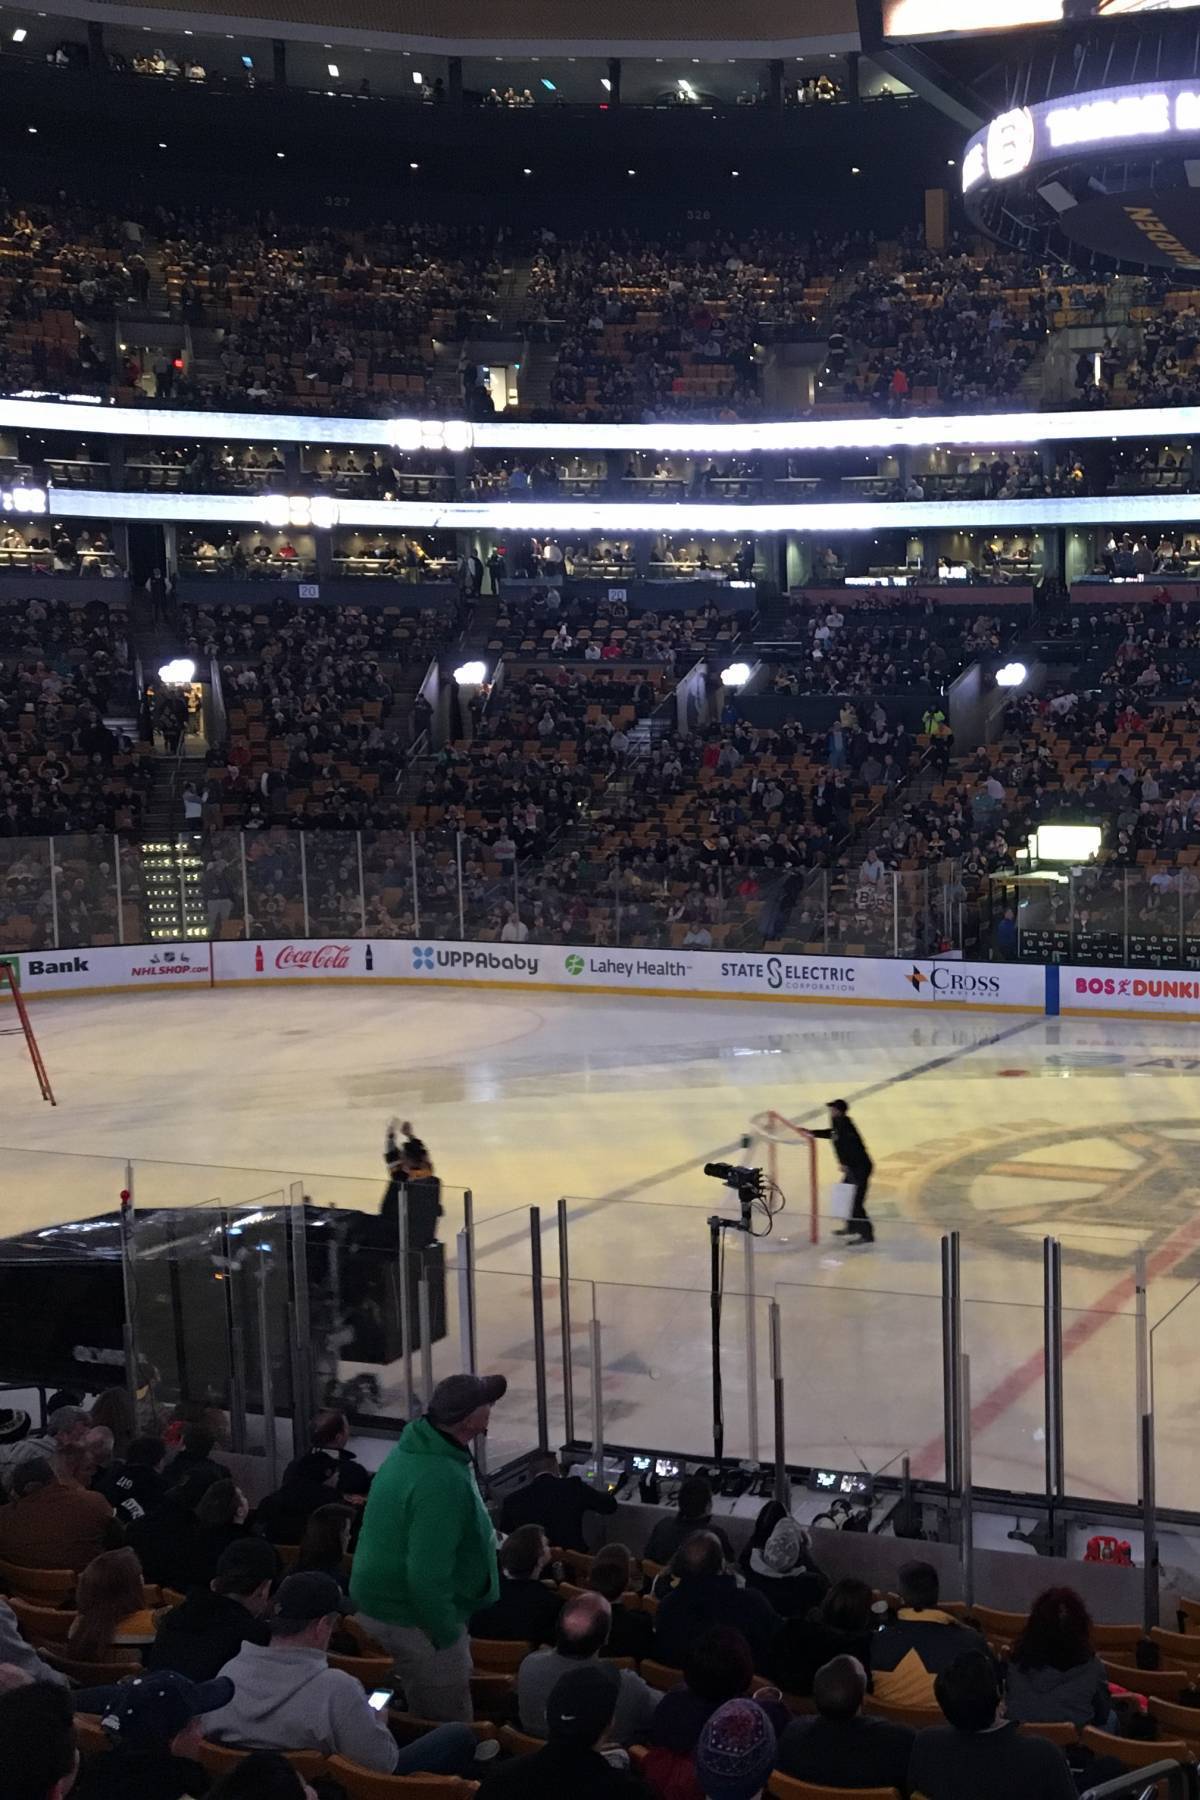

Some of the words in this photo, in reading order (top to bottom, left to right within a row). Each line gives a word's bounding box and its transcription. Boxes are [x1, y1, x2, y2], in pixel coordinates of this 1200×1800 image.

[28, 957, 89, 975] Bank
[275, 945, 352, 969] Coca-Cola
[437, 950, 539, 975] UPPAbaby
[590, 958, 633, 975] Lahey
[637, 961, 686, 977] Health
[721, 962, 764, 978] STATE
[786, 966, 855, 982] ELECTRIC
[930, 968, 1000, 992] CROSS
[1076, 978, 1115, 995] BOS
